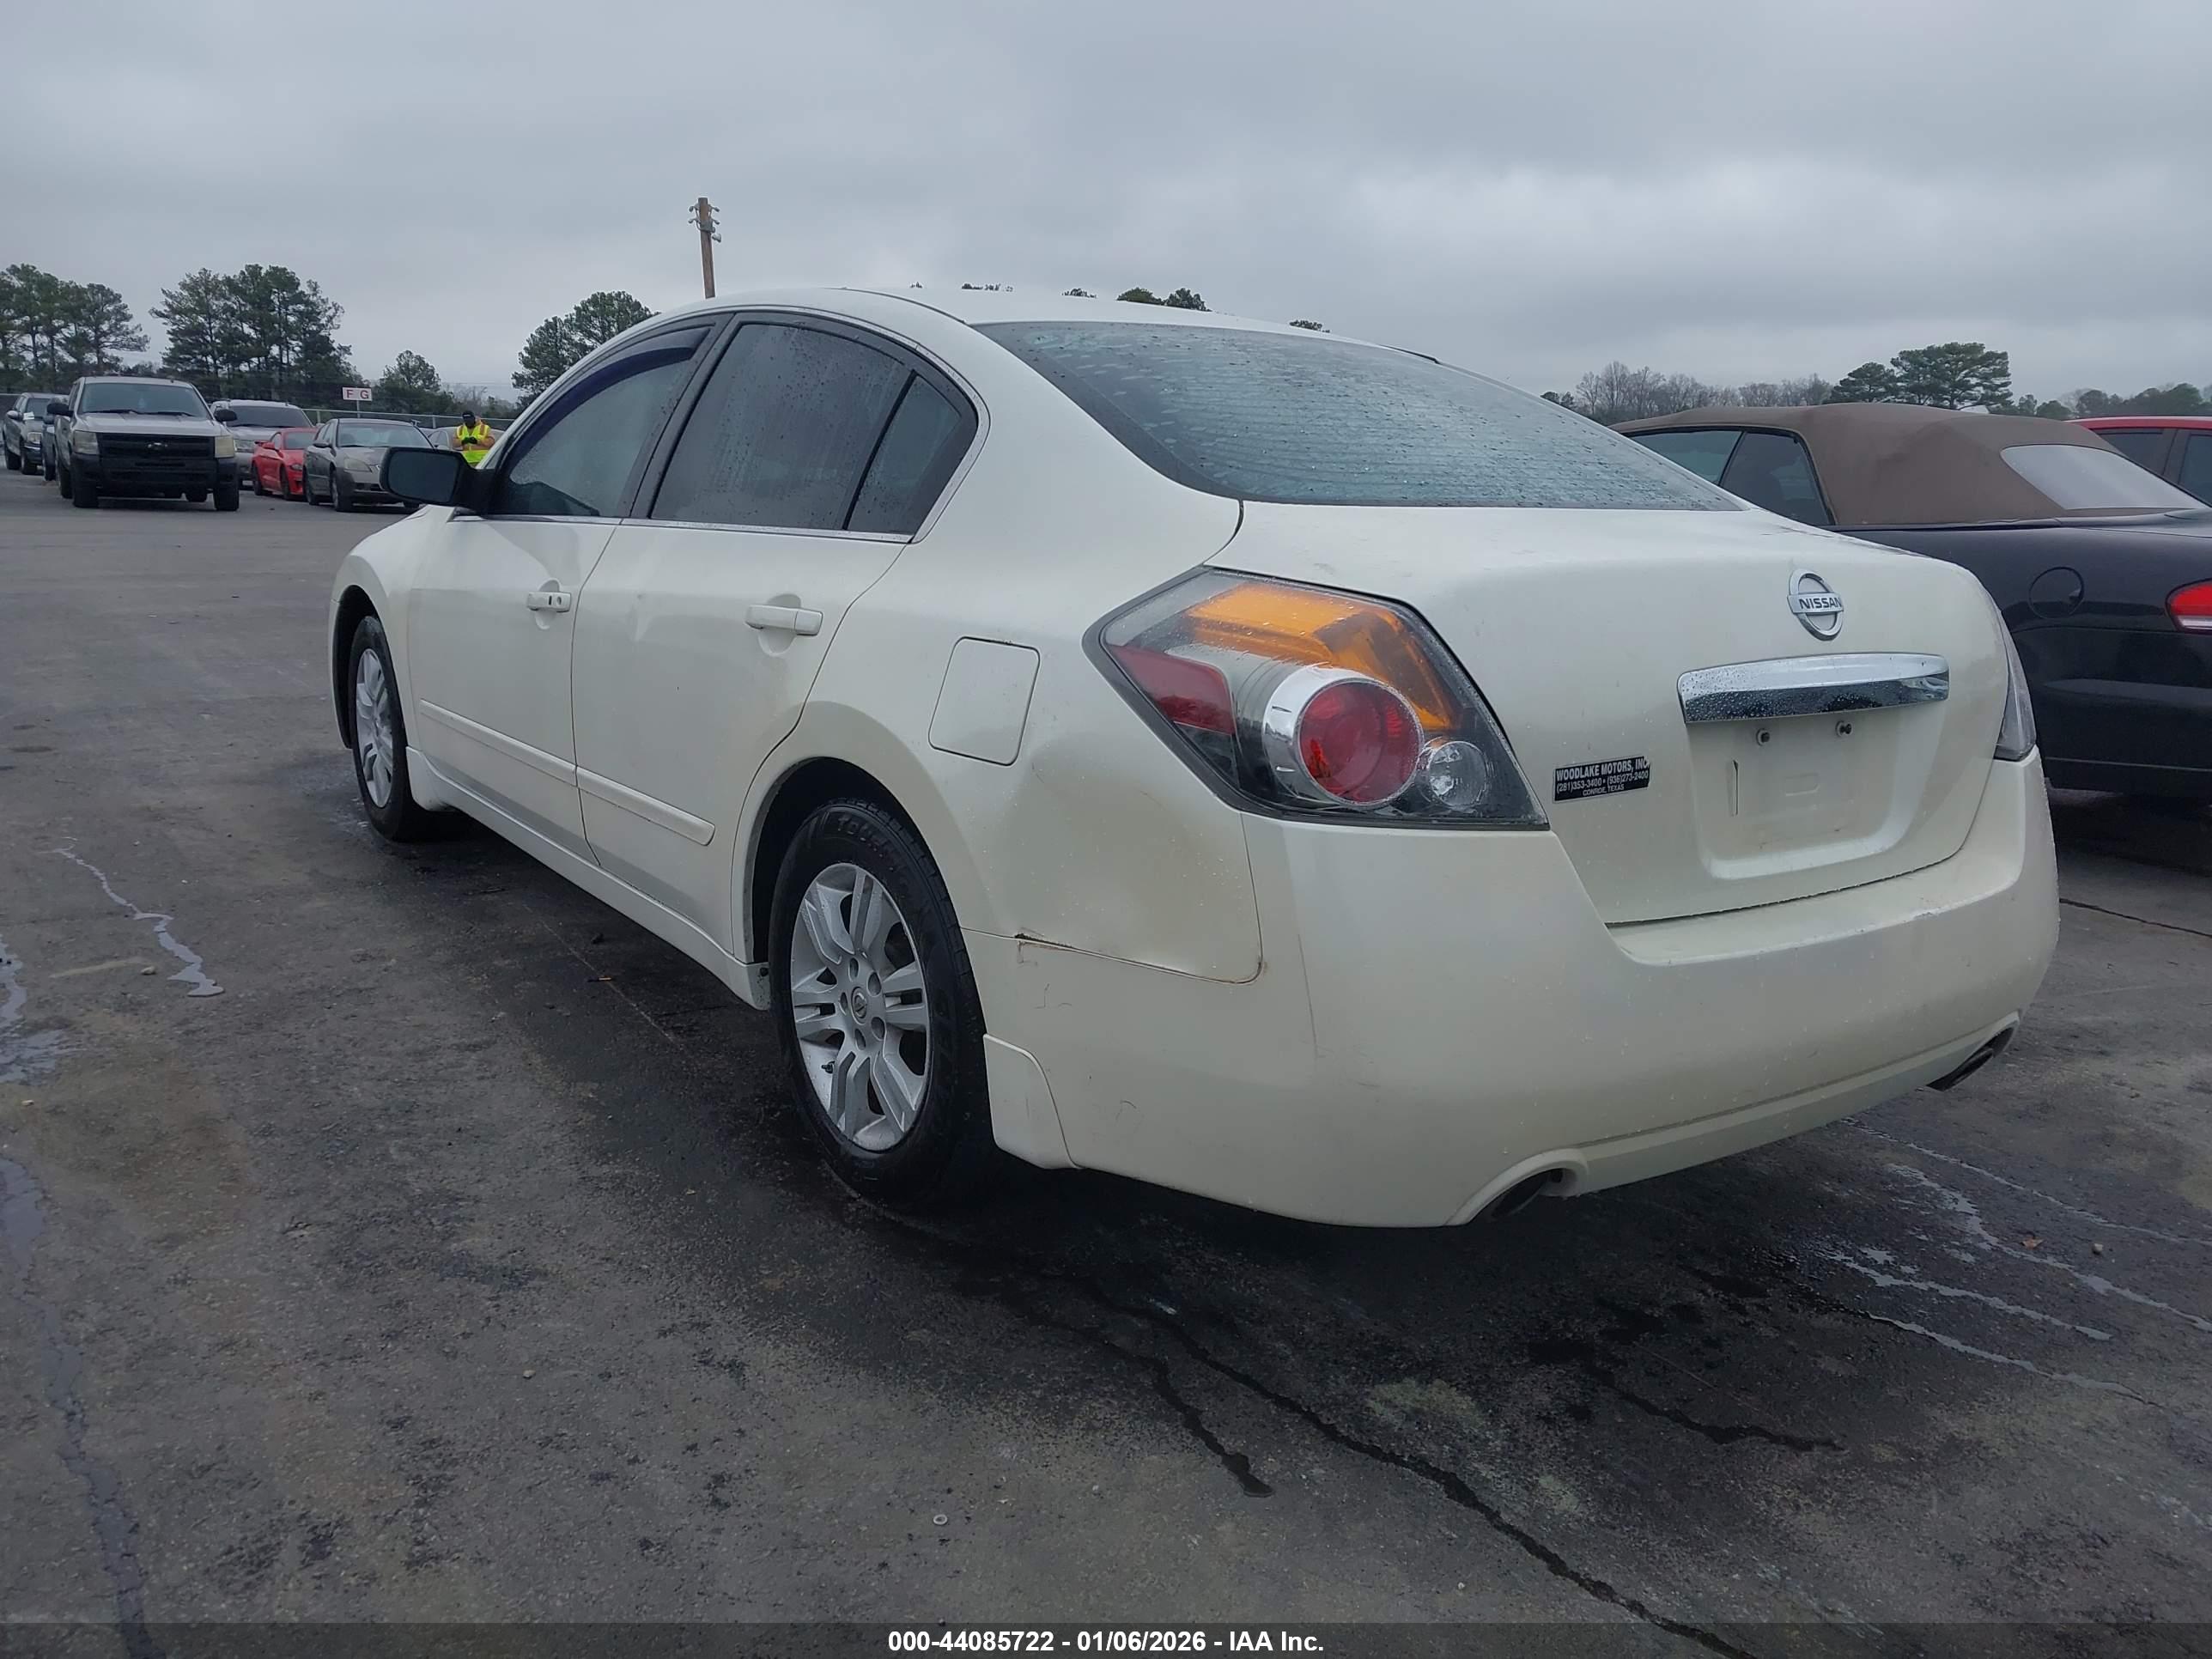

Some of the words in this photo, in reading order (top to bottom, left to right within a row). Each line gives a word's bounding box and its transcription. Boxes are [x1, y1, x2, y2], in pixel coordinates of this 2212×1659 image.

[347, 390, 354, 398] F
[361, 390, 369, 399] G
[1798, 597, 1843, 610] NISSAN
[1556, 766, 1599, 781] WOODLAKE
[1601, 760, 1633, 775] MOTORS,
[1607, 783, 1625, 793] TEXAS
